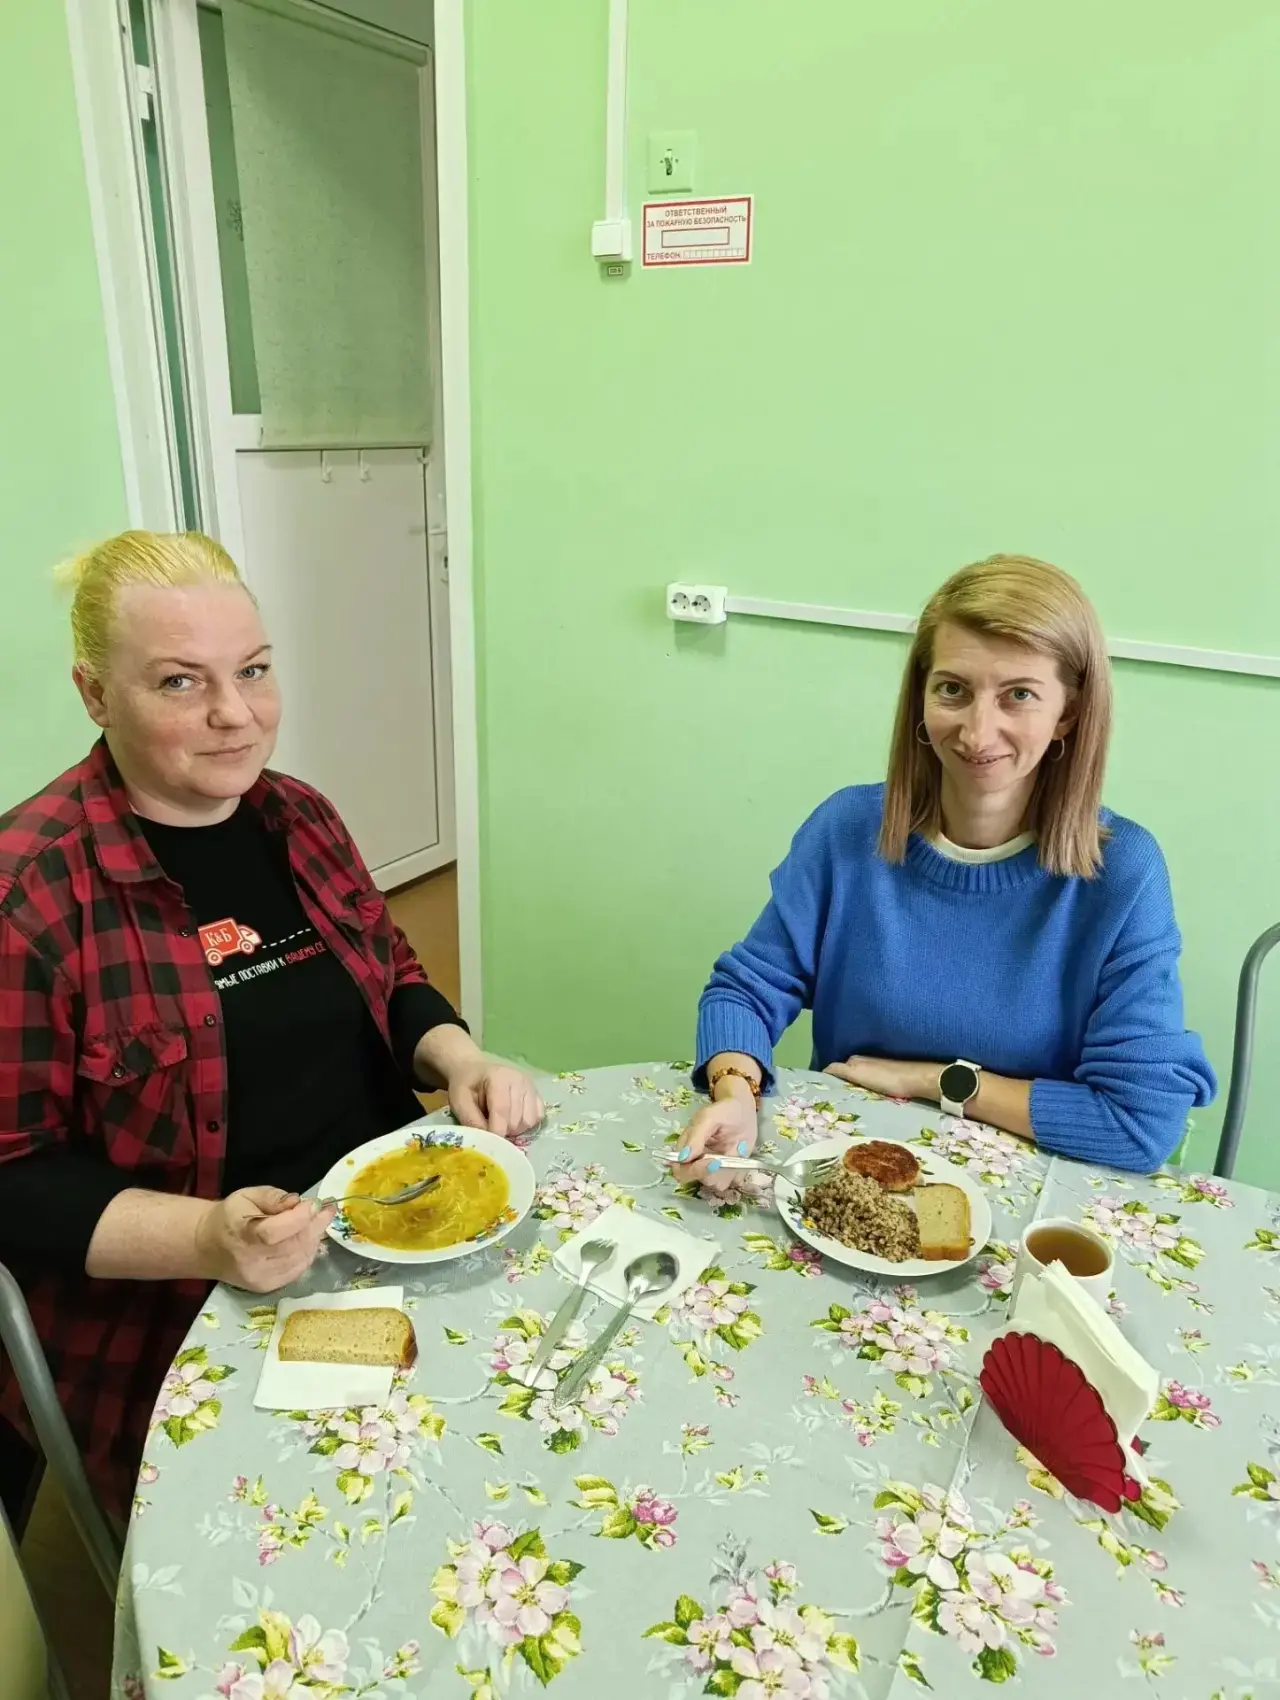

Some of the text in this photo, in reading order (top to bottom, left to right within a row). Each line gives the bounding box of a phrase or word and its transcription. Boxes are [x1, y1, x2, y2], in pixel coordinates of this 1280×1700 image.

[665, 206, 727, 217] ОТВЕТСТВЕННЫЙ
[656, 219, 692, 227] ПОЖАРНУЮ
[694, 215, 746, 224] БЕЗОПАСНОСТЬ
[205, 928, 232, 947] К&Б
[238, 959, 279, 981] ПОСТАВКИ
[277, 957, 286, 967] К
[285, 945, 317, 964] ВАШЕМУ
